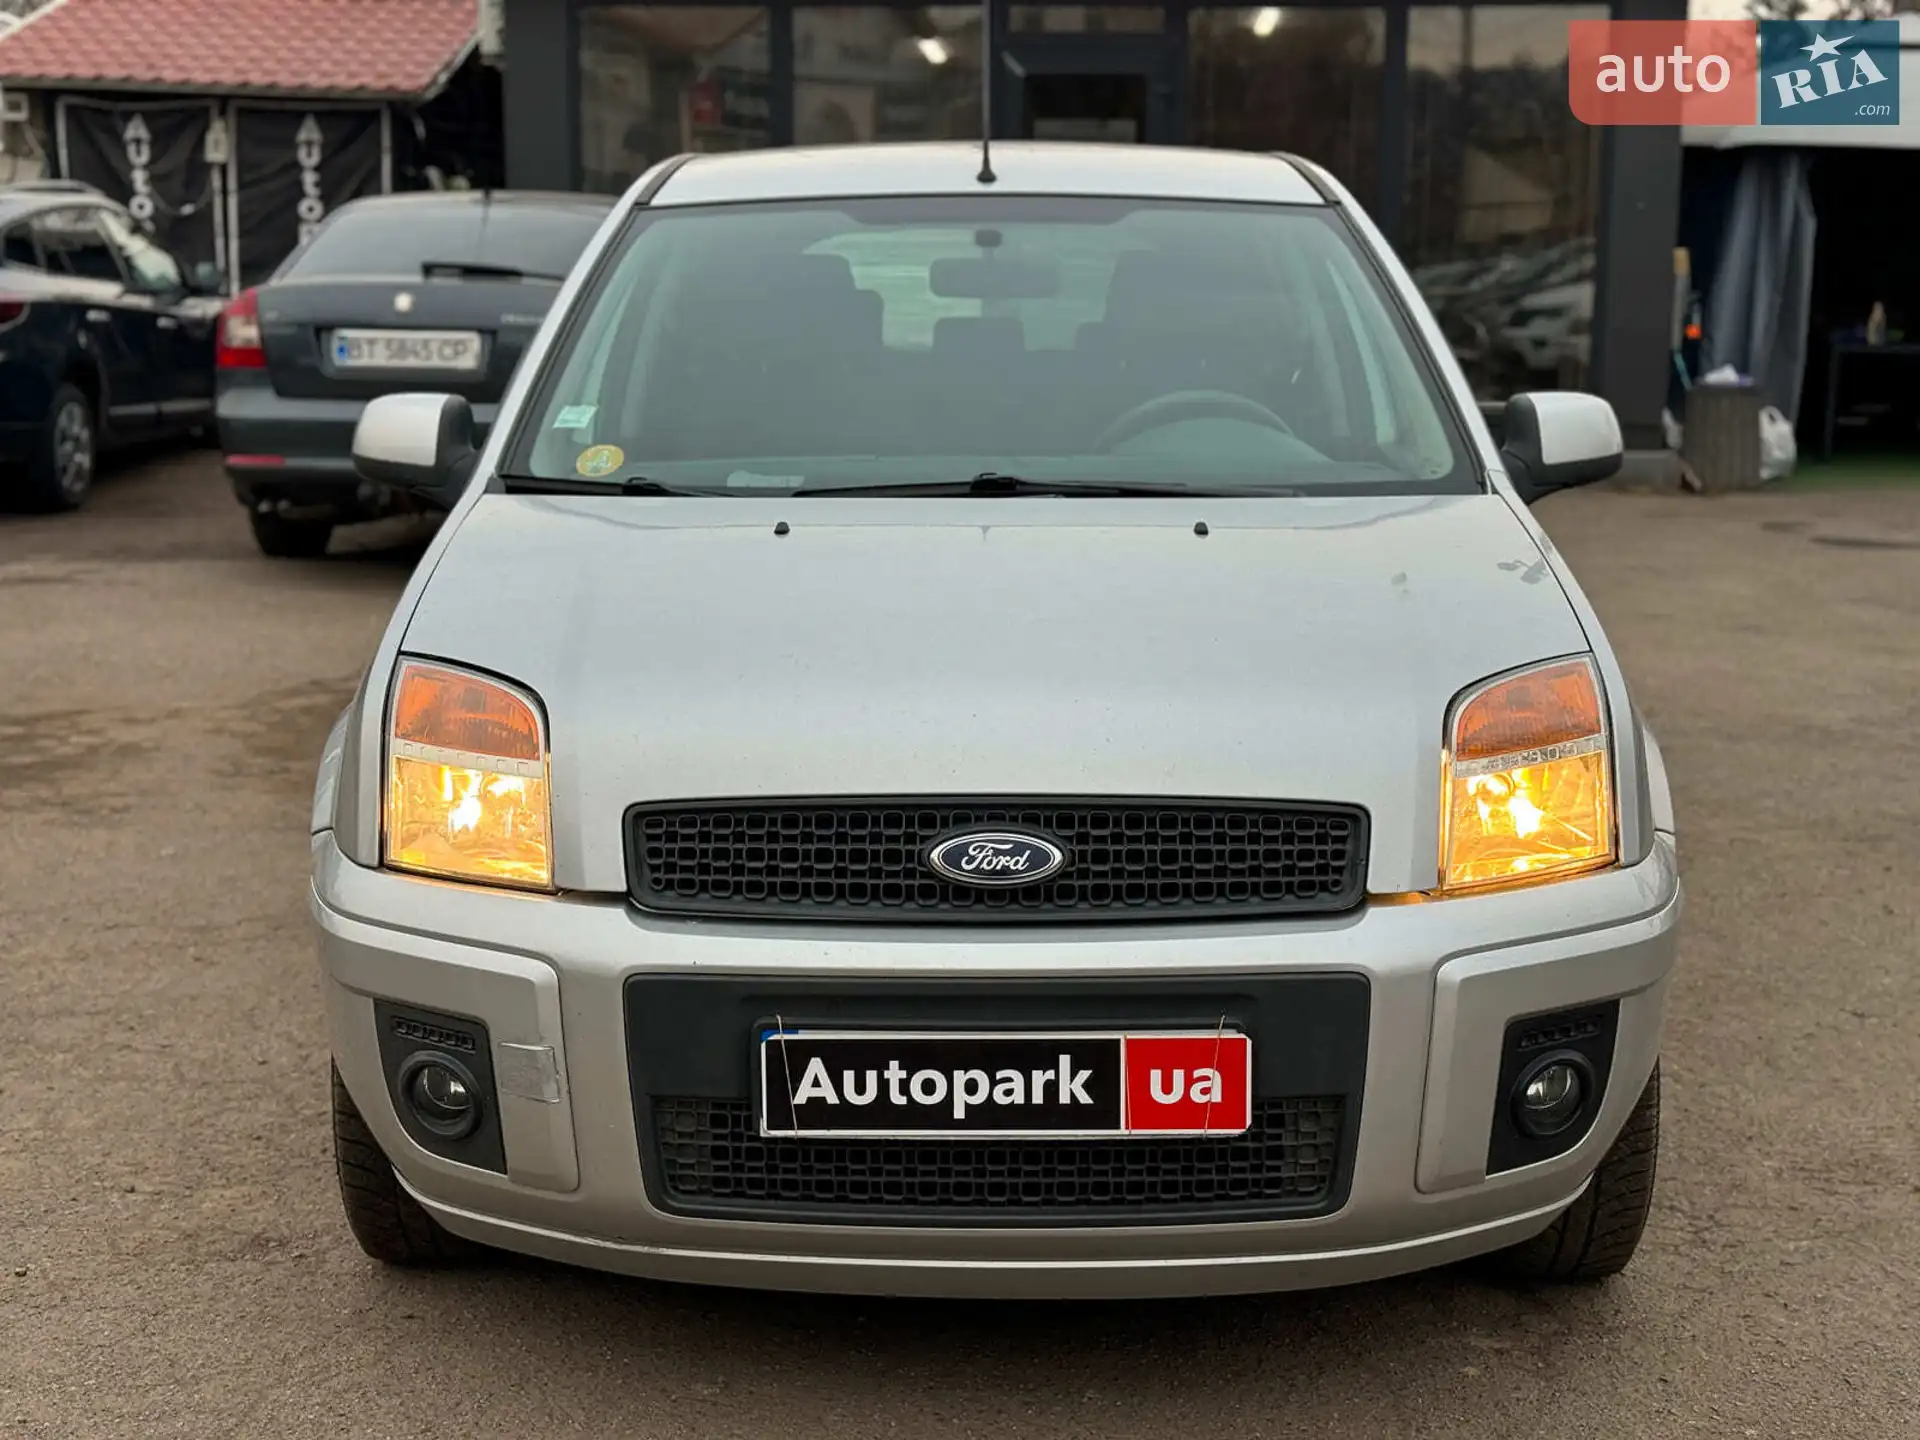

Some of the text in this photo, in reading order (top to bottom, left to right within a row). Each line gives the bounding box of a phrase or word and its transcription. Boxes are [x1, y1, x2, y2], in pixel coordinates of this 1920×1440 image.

[961, 841, 1031, 871] Ford
[793, 1054, 1223, 1119] Autopark ua
